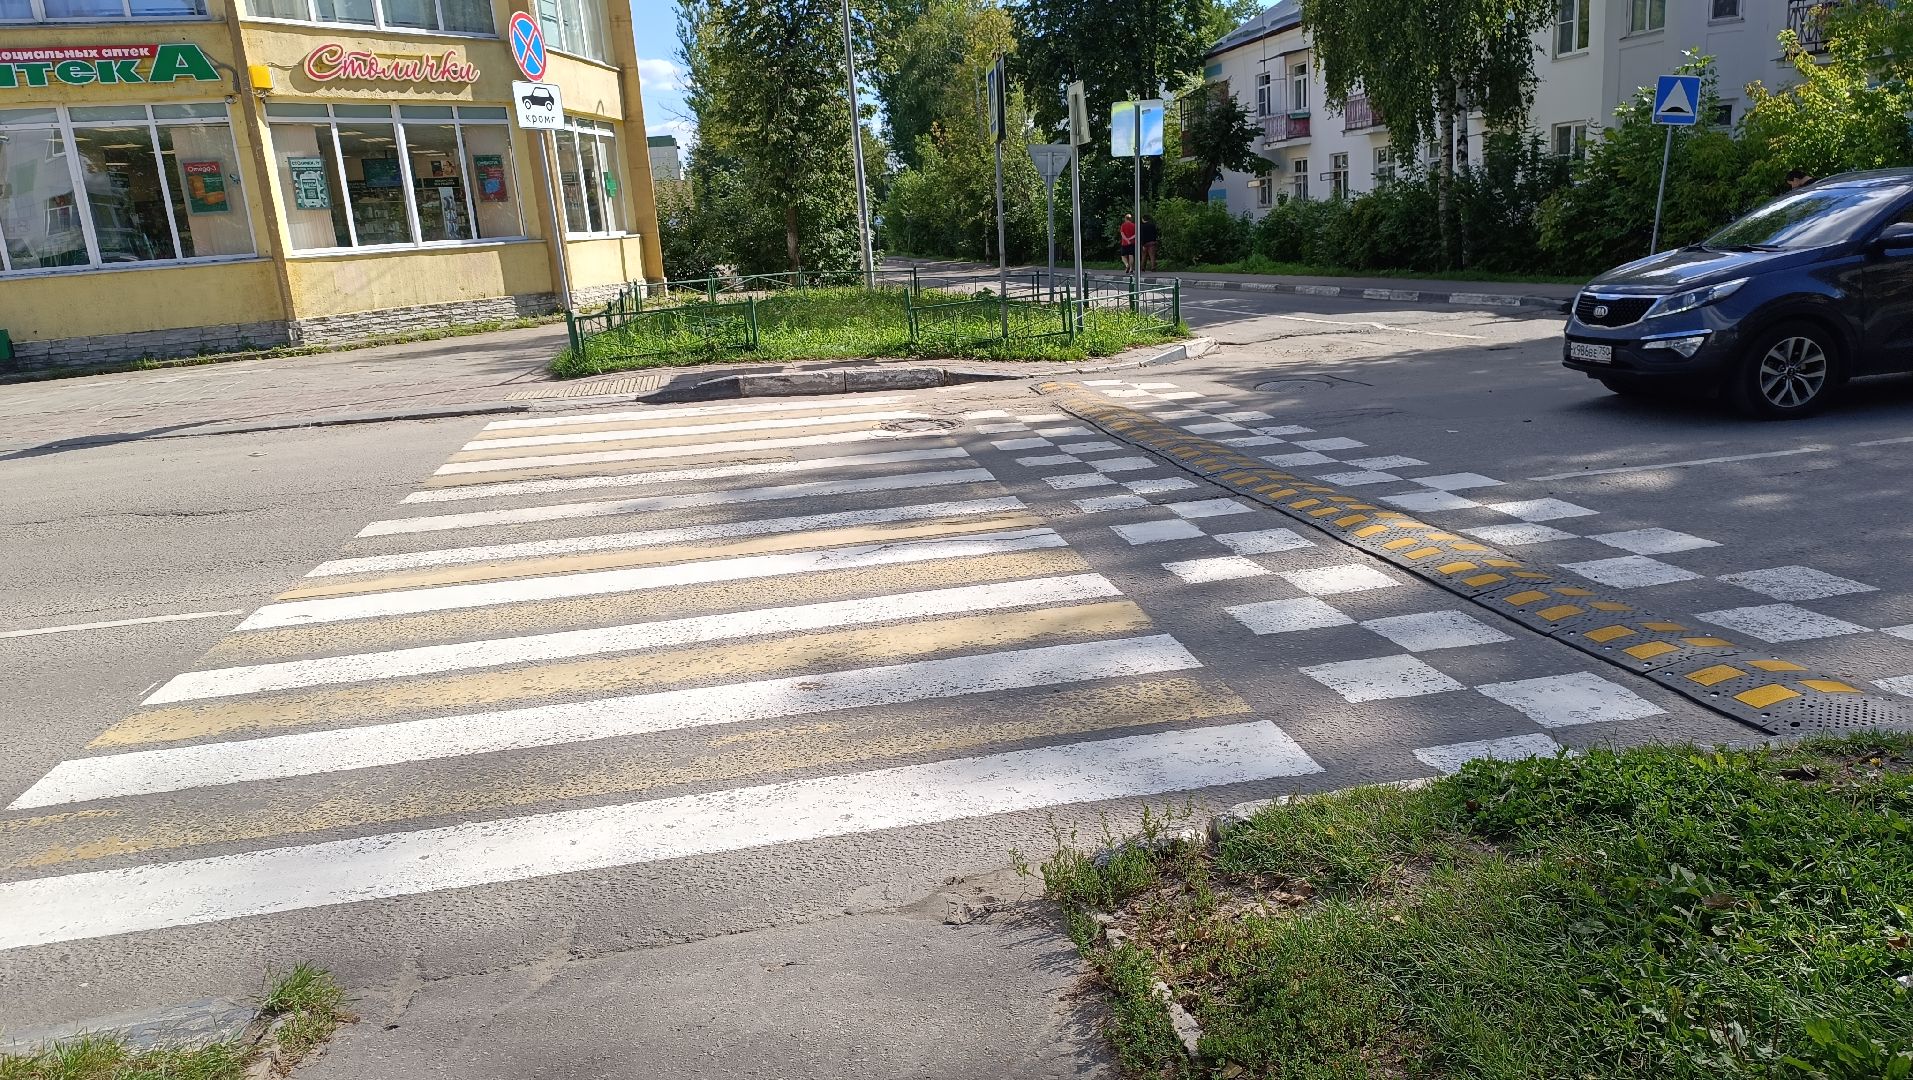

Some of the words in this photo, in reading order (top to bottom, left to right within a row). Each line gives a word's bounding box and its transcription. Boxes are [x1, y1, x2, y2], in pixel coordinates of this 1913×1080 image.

[0, 48, 99, 61] оциальных
[101, 47, 150, 58] аптек
[304, 43, 480, 82] Столички
